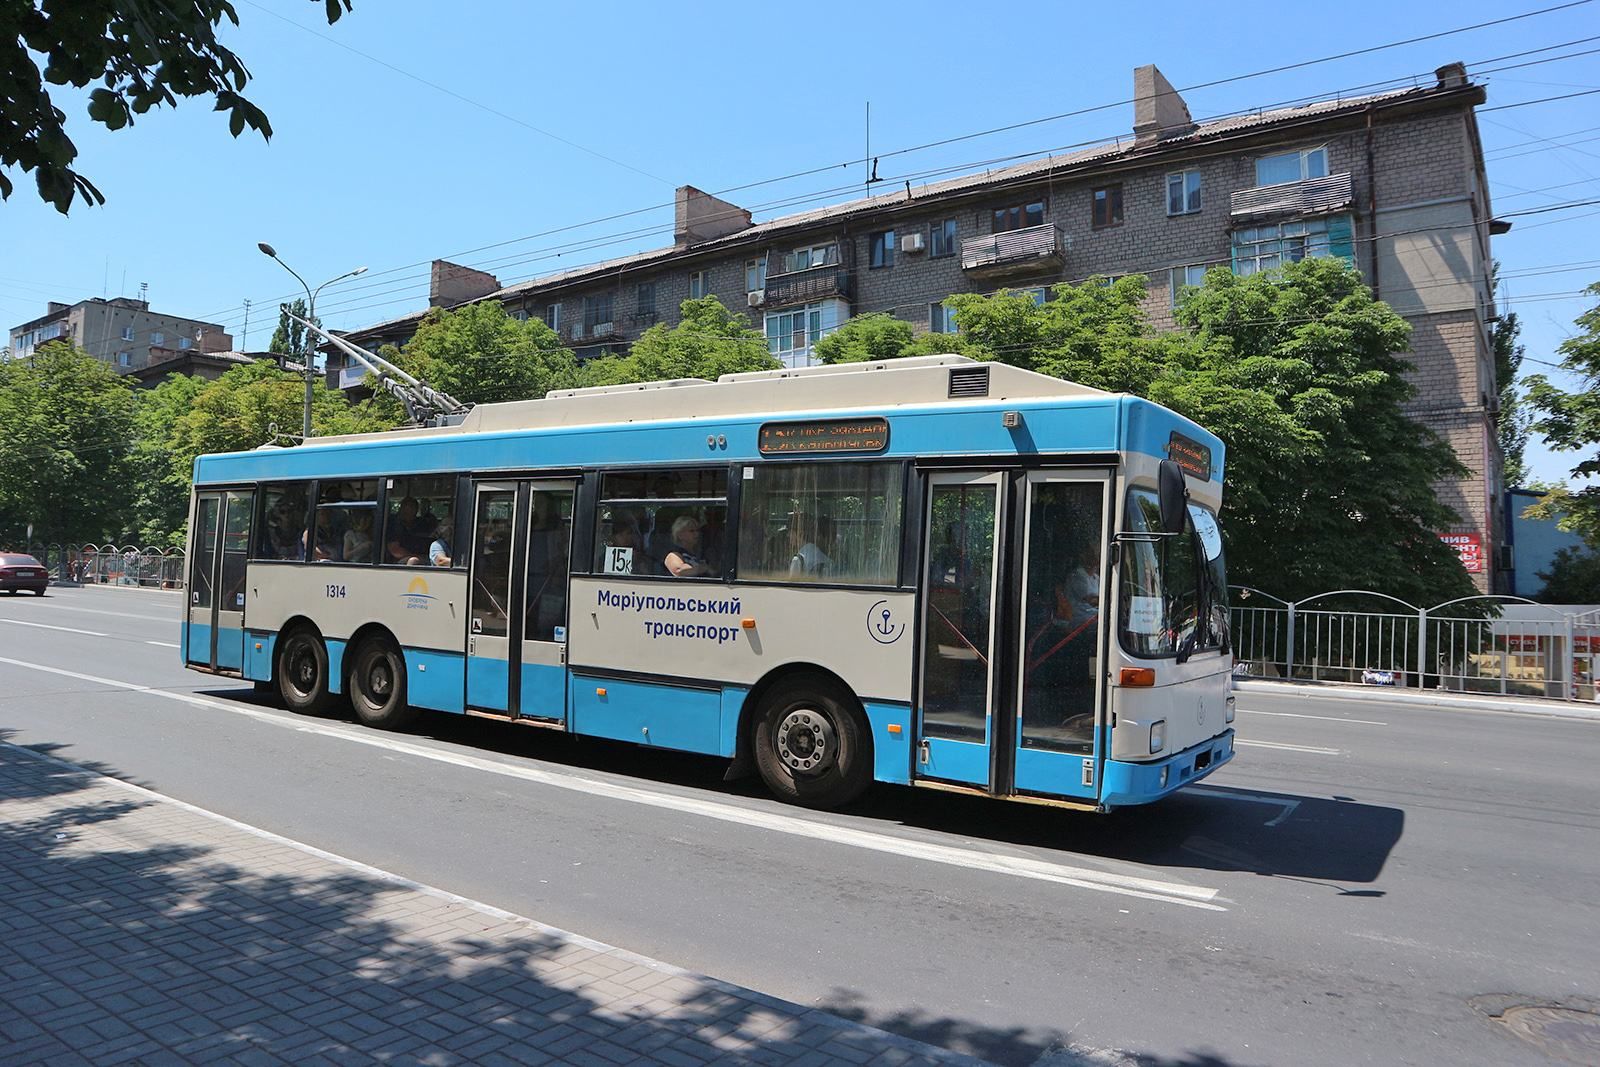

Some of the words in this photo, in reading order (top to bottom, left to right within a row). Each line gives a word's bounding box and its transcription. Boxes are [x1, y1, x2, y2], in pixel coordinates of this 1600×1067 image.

[326, 585, 346, 598] 1314
[598, 590, 741, 615] Маріупольський
[644, 621, 740, 644] транспорт
